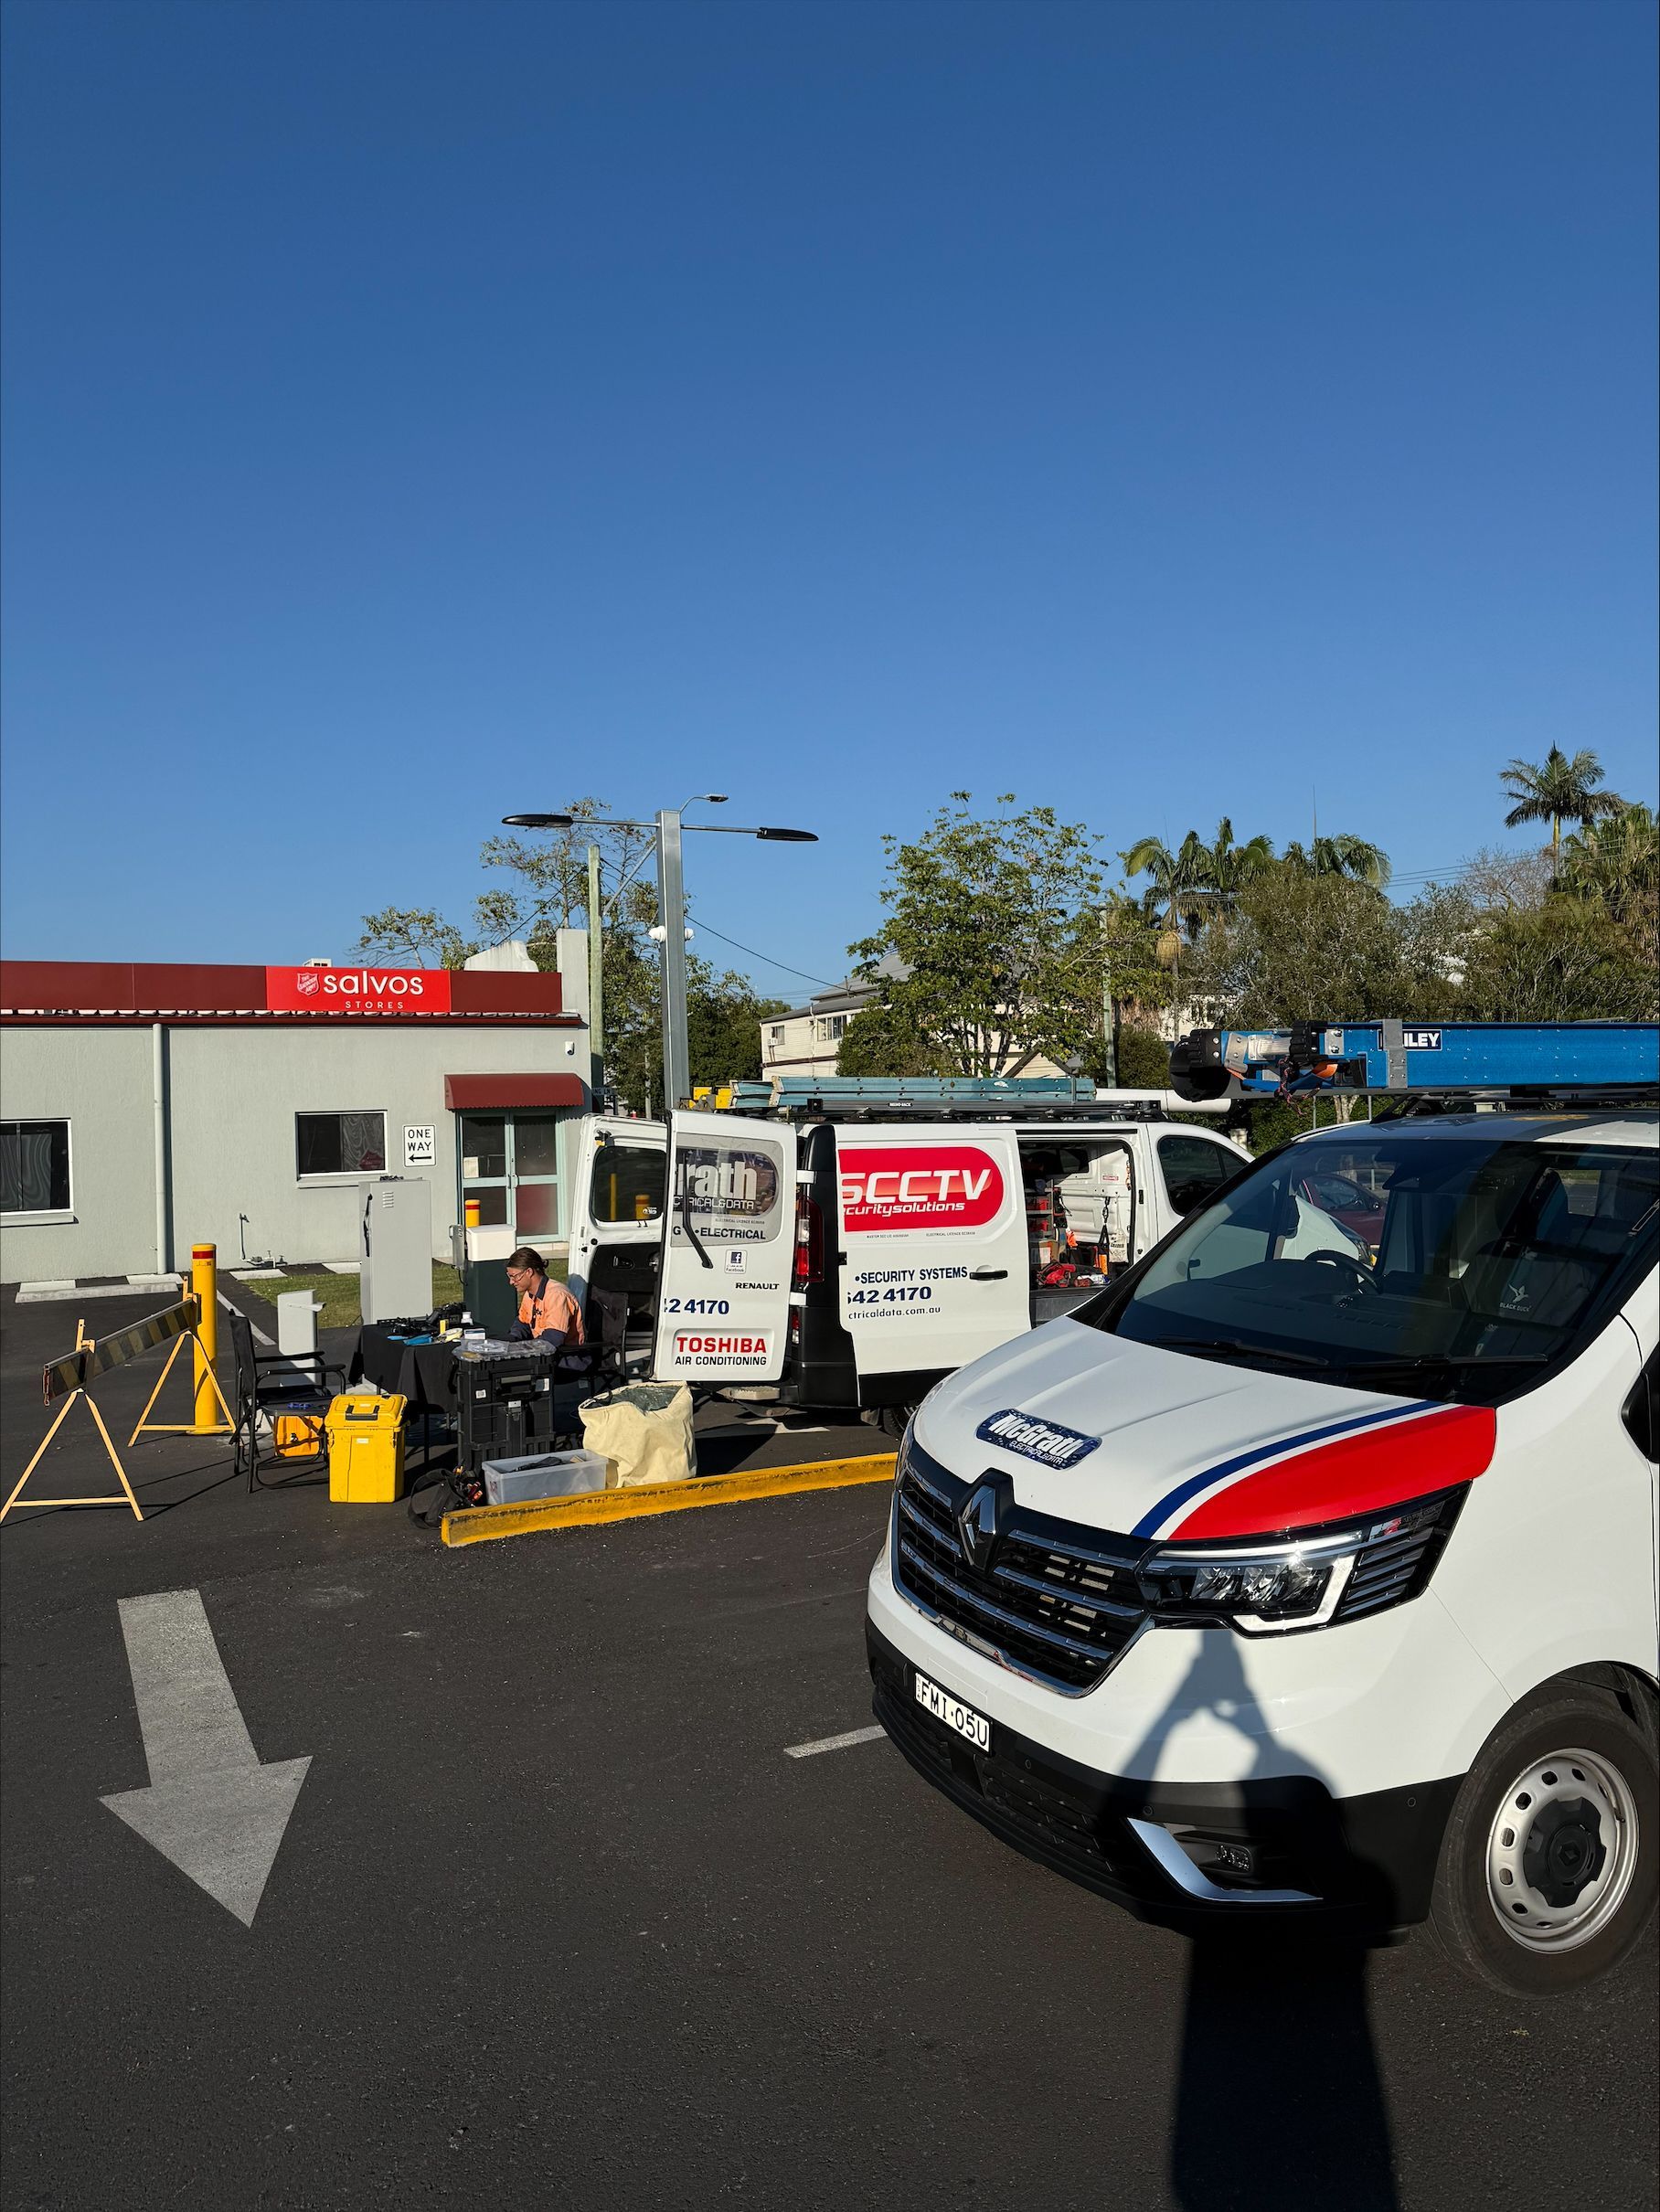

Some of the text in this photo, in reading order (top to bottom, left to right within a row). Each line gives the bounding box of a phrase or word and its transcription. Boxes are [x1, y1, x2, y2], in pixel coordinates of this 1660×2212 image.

[323, 970, 424, 995] salvos
[345, 1001, 403, 1009] STORES
[408, 1129, 431, 1138] ONE
[408, 1142, 431, 1151] WAY
[841, 1169, 991, 1204] SCCTV
[920, 1267, 968, 1281] SYSTEMS
[735, 1282, 780, 1291] RENAULT
[883, 1286, 931, 1302] 4170
[664, 1298, 729, 1314] 2 4170
[848, 1307, 941, 1320] ctricaldata.com.au
[676, 1337, 767, 1354] TOSHIBA
[675, 1356, 767, 1367] AIR CONDITIONING
[987, 1413, 1085, 1459] McGrath
